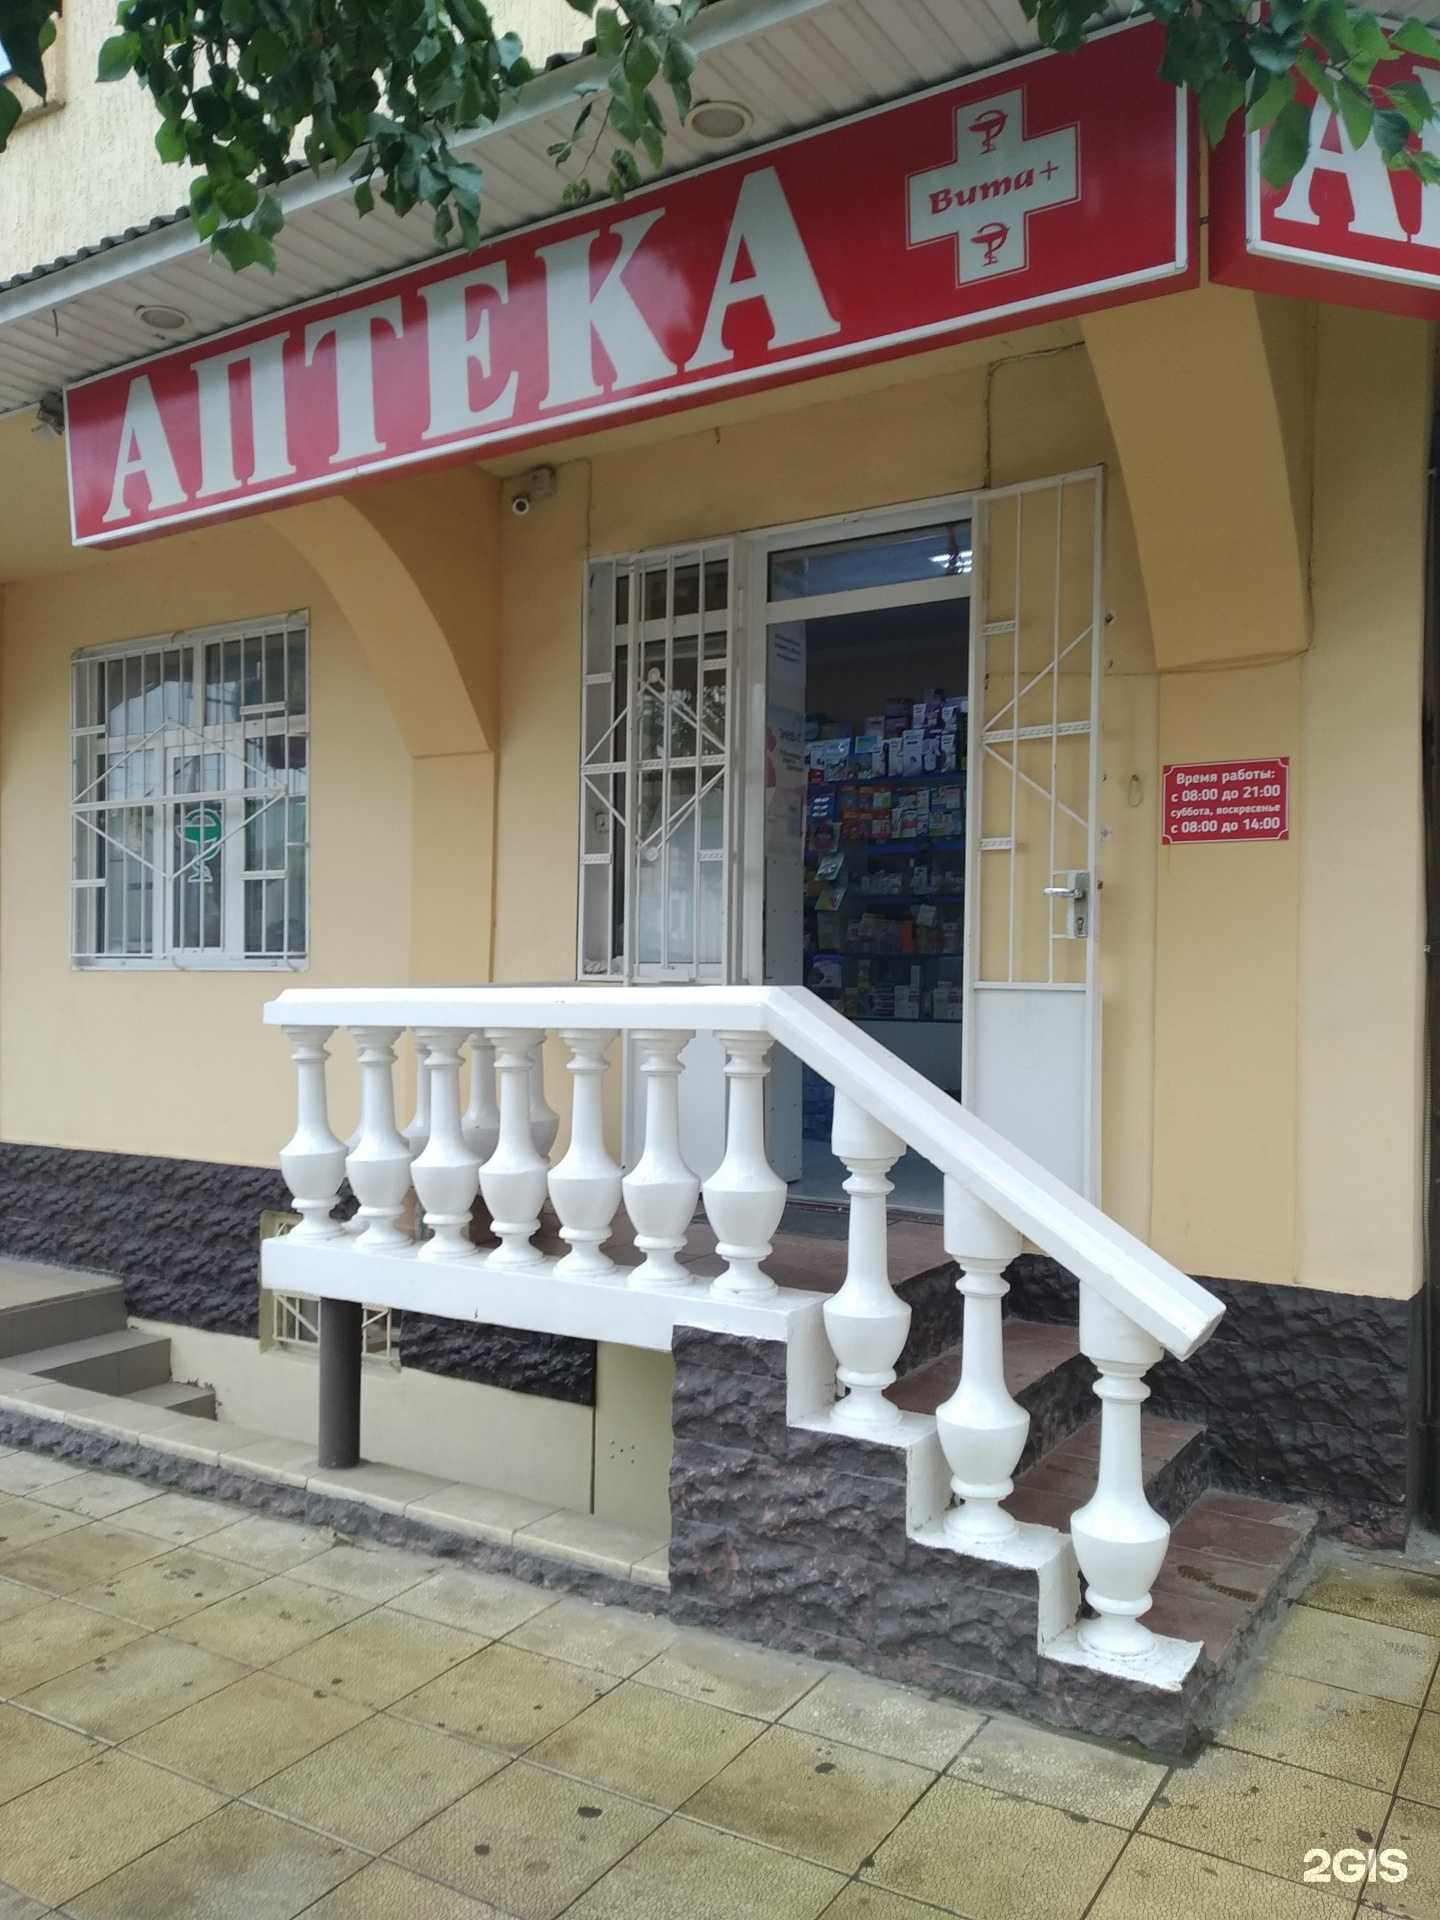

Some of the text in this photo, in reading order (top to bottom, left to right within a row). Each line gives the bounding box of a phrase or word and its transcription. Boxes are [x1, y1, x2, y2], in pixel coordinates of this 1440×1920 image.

[102, 166, 841, 523] АПТЕКА
[1176, 769, 1276, 786] Время работы:
[1170, 785, 1281, 802] с 08:00 до 21:00
[1170, 804, 1281, 818] суббота, воскресенье
[1170, 817, 1281, 833] с 08:00 до 14:00
